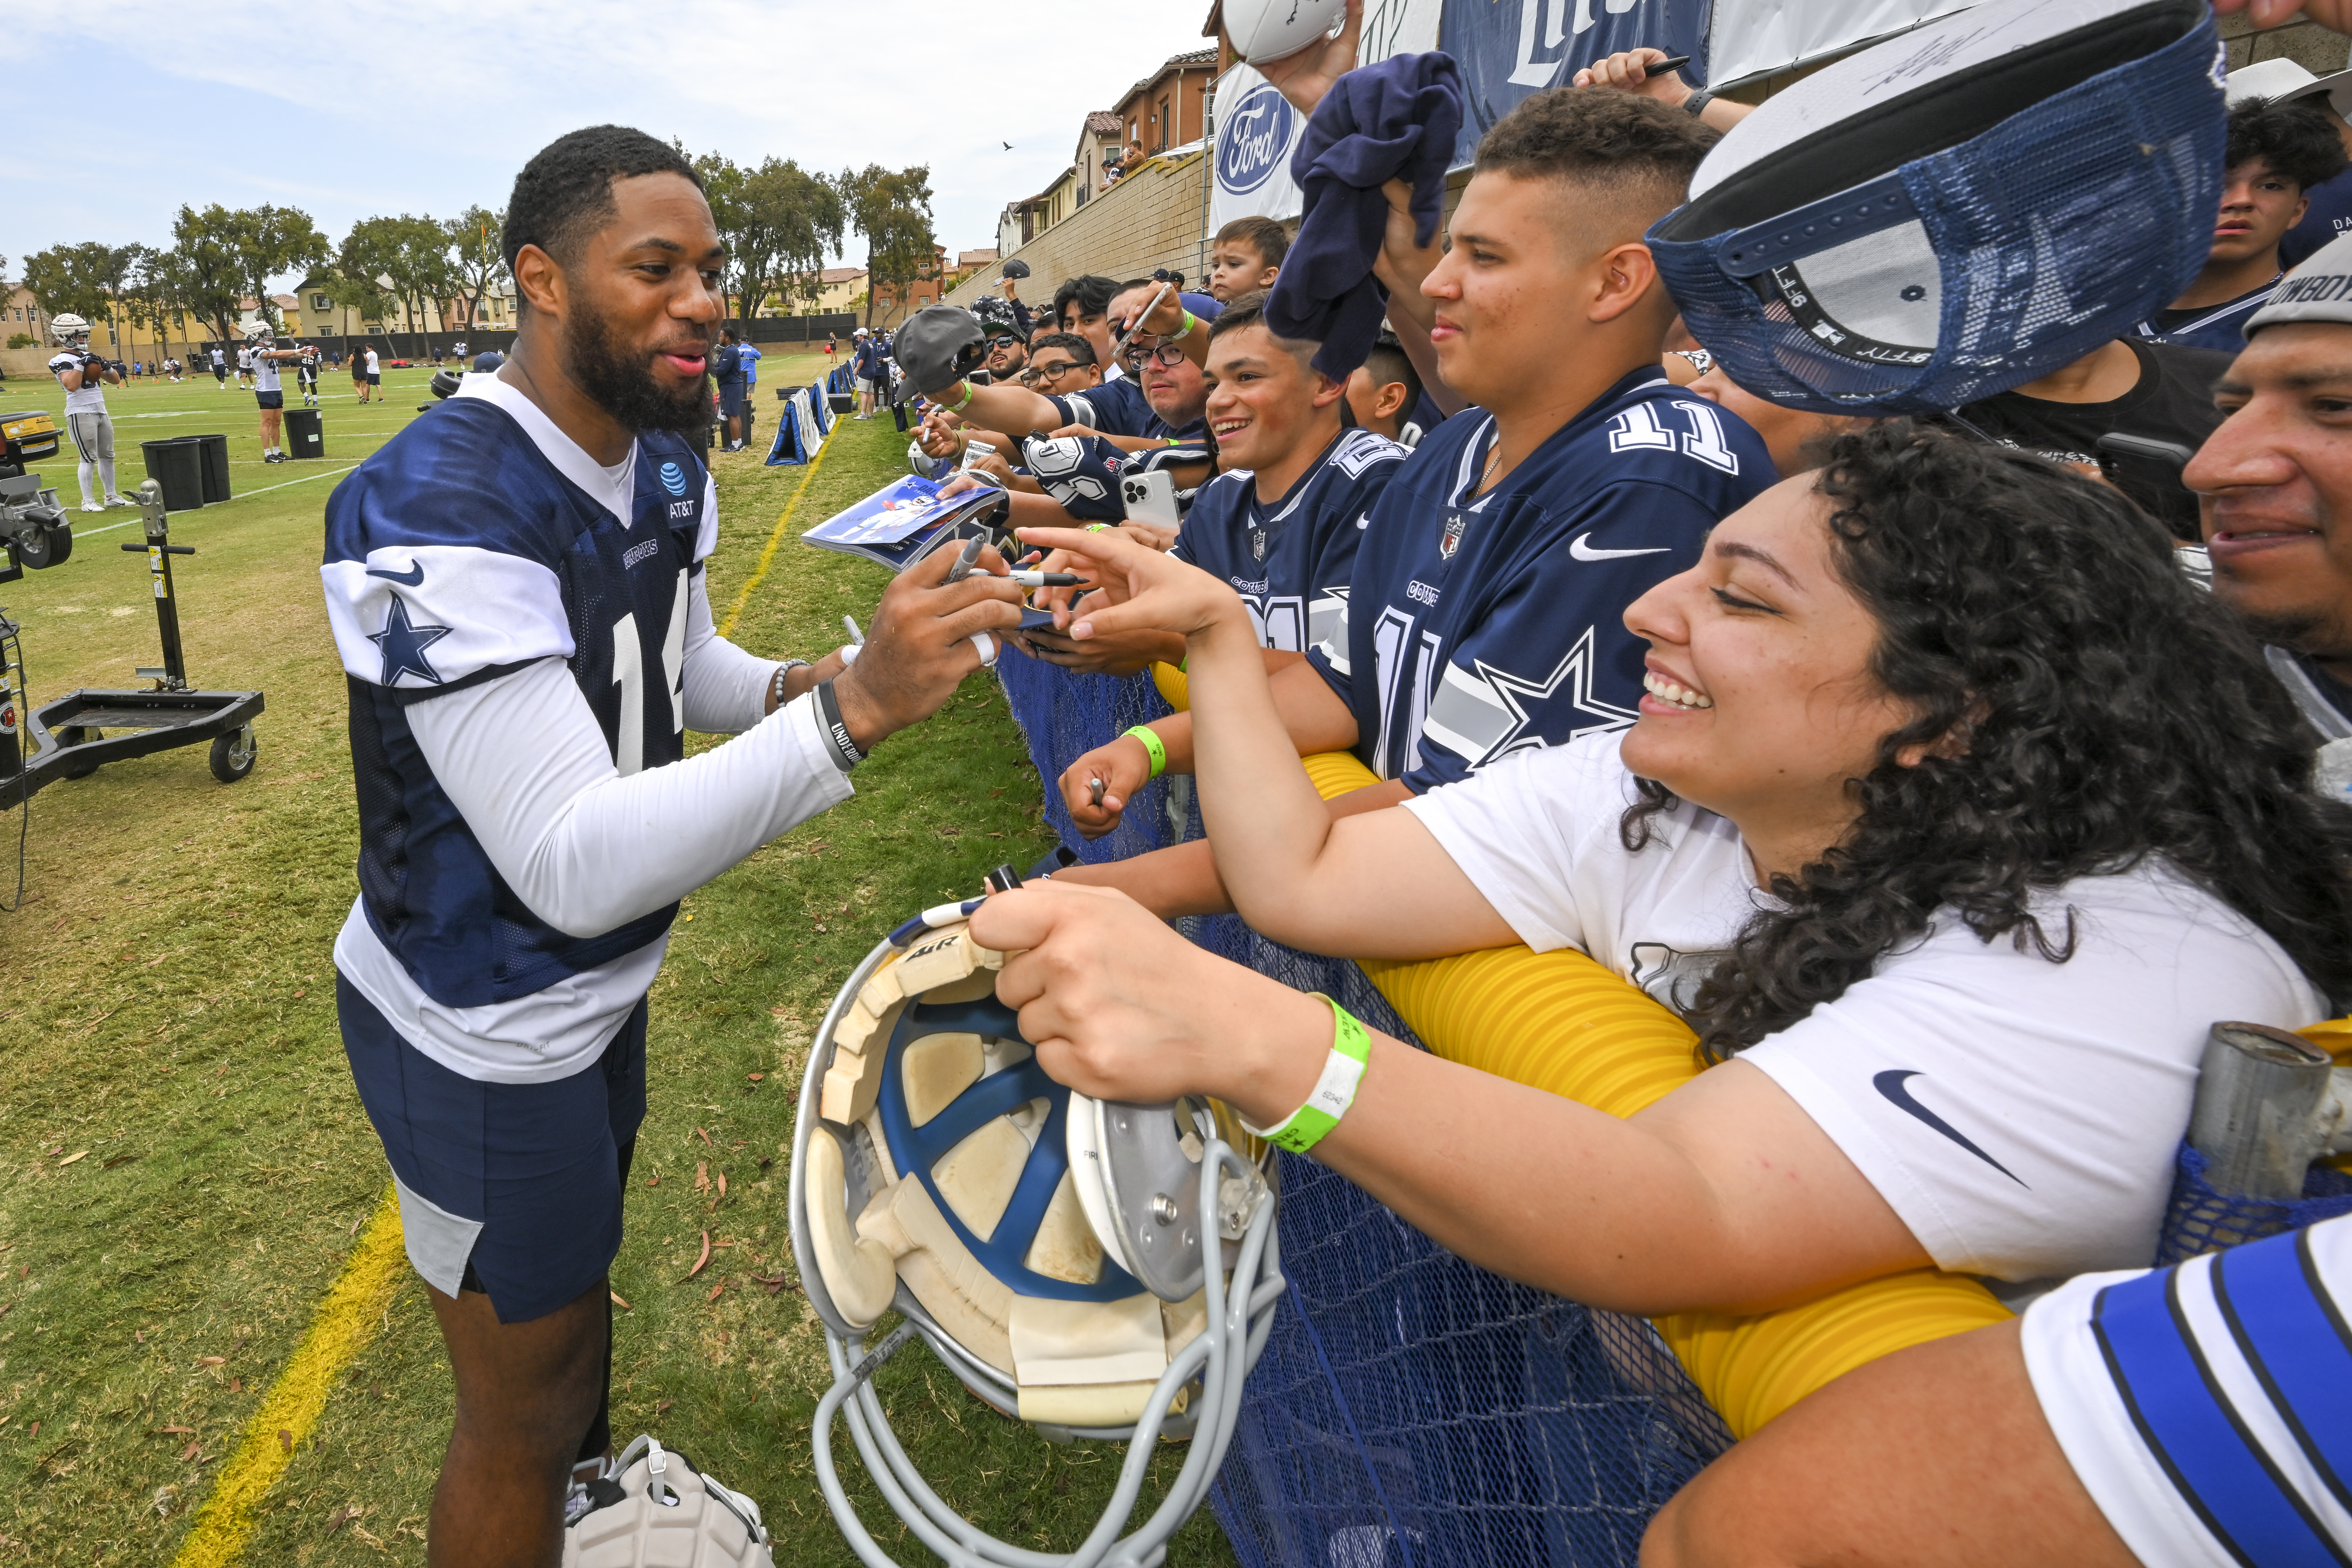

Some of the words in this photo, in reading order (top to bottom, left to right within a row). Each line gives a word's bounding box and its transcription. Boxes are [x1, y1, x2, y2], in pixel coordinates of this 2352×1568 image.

[1228, 103, 1278, 178] Ford
[1606, 401, 1739, 476] 11
[670, 500, 694, 519] AT&T
[1444, 534, 1457, 552] NFL
